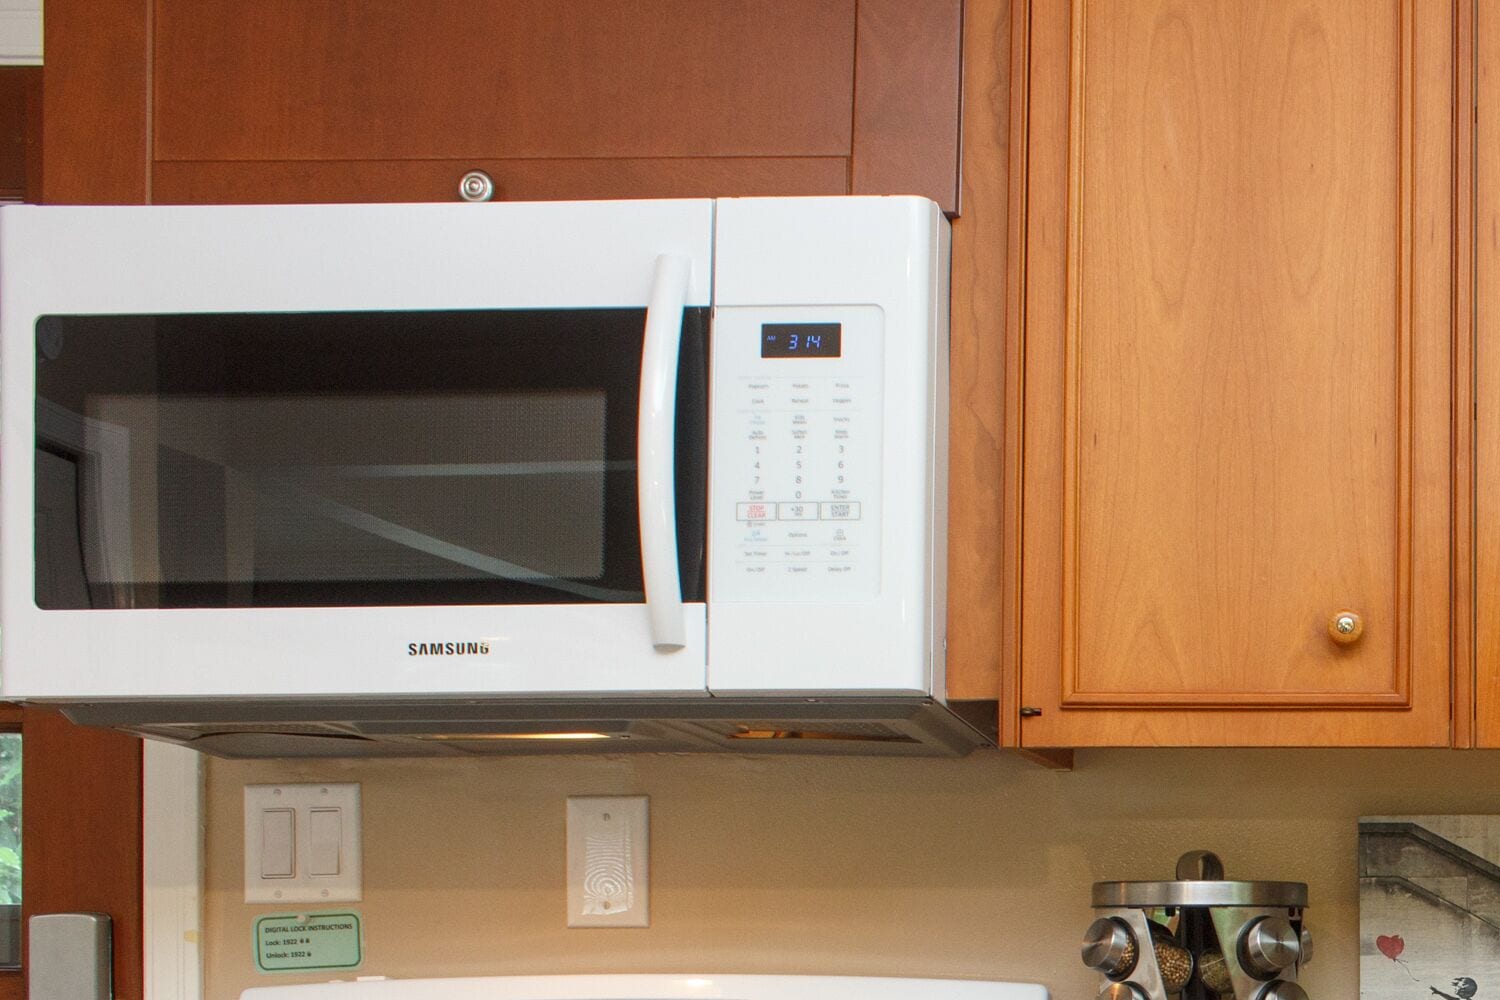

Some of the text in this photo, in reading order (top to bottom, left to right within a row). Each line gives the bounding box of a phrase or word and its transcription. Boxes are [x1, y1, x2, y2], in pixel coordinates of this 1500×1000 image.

[830, 504, 850, 512] ENTER
[408, 642, 490, 656] SAMSUNG
[265, 926, 289, 934] DIGITAL
[307, 923, 353, 932] INSTRUCTIONS
